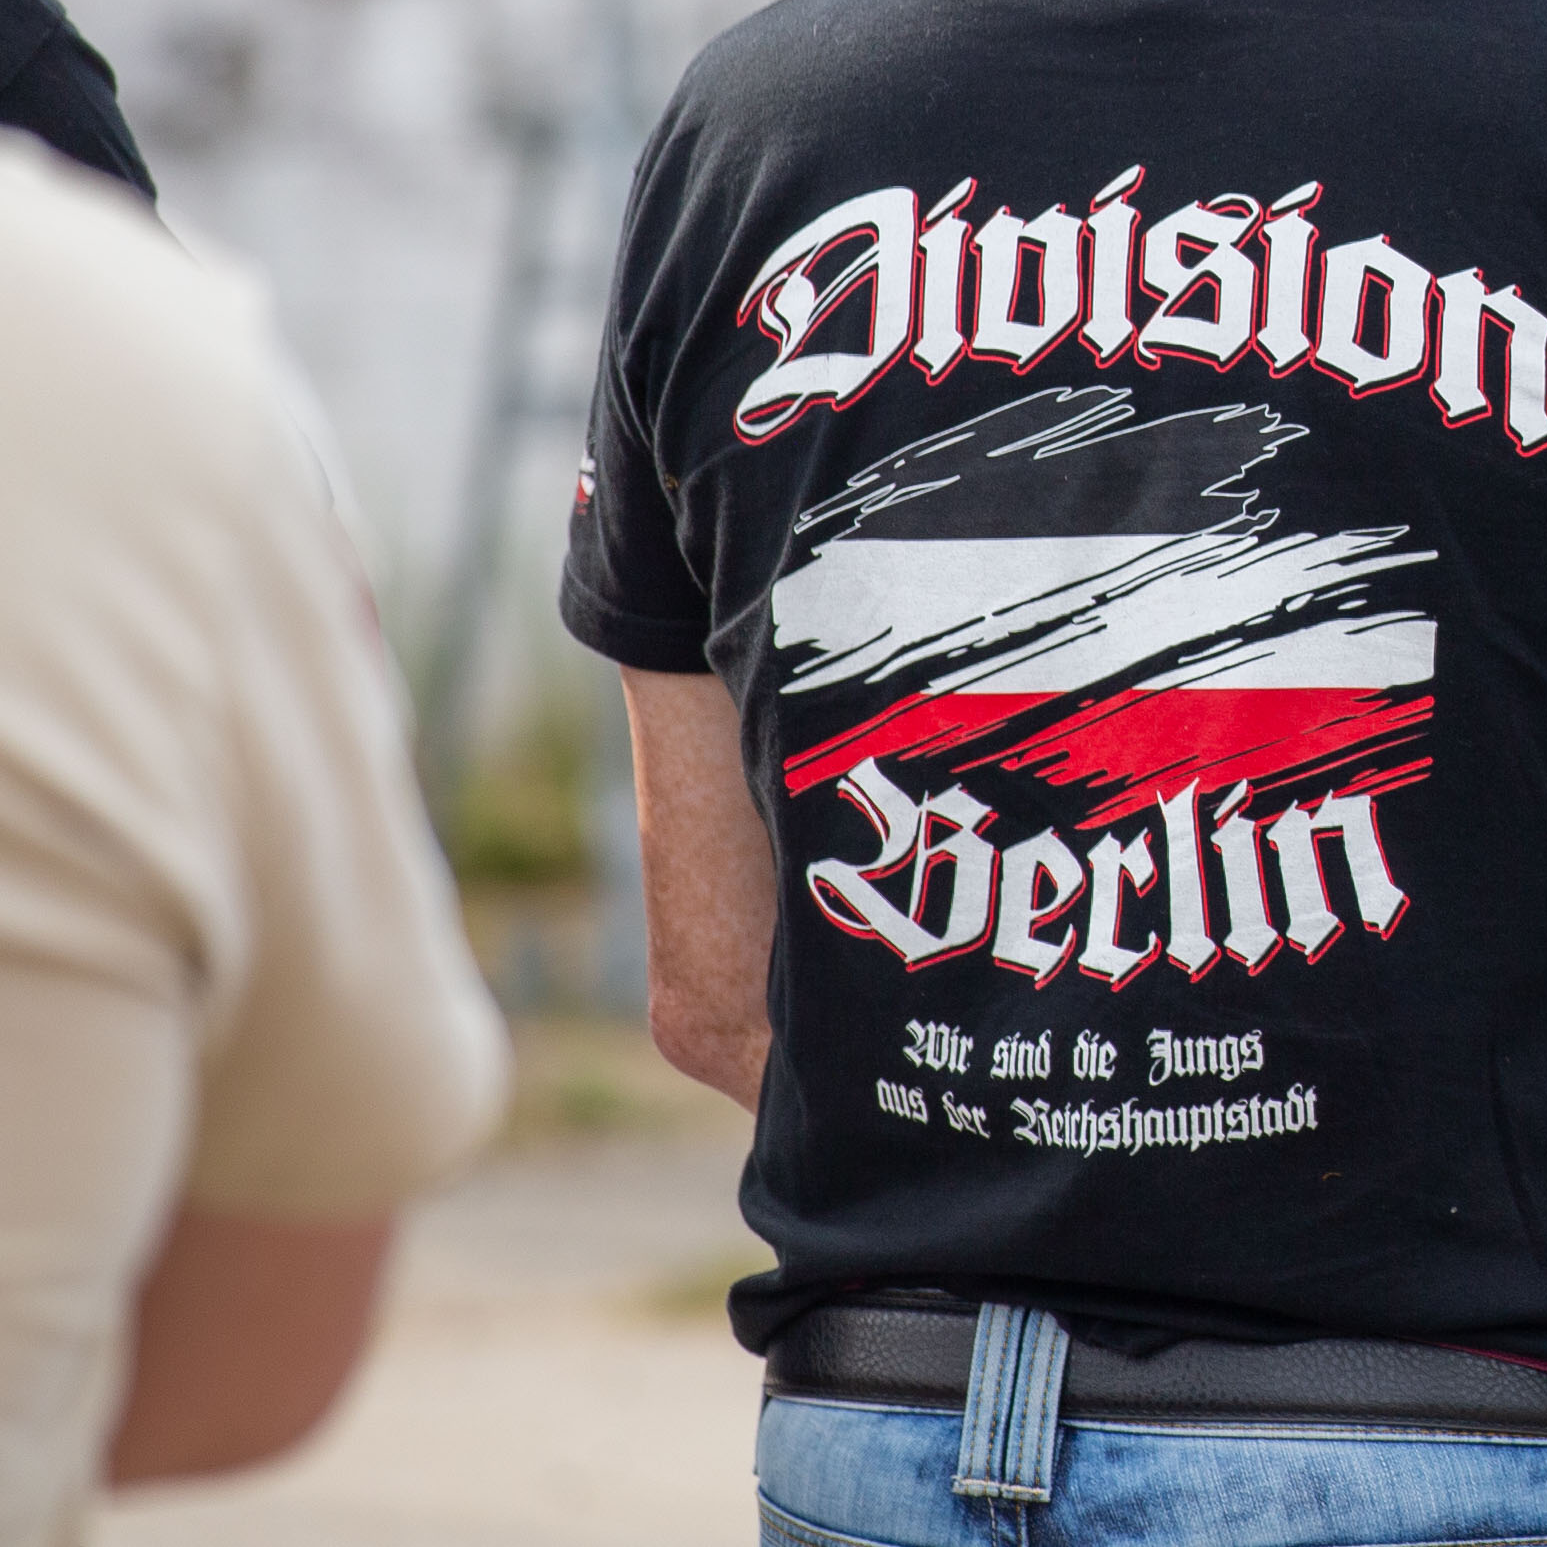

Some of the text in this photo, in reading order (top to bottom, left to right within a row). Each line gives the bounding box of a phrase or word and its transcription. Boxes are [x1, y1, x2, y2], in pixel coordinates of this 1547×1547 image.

[805, 756, 1410, 991] Berlin
[902, 1018, 1264, 1087] Wir sind die Jungs
[876, 1077, 1319, 1159] aus der Reichshauptstadt
